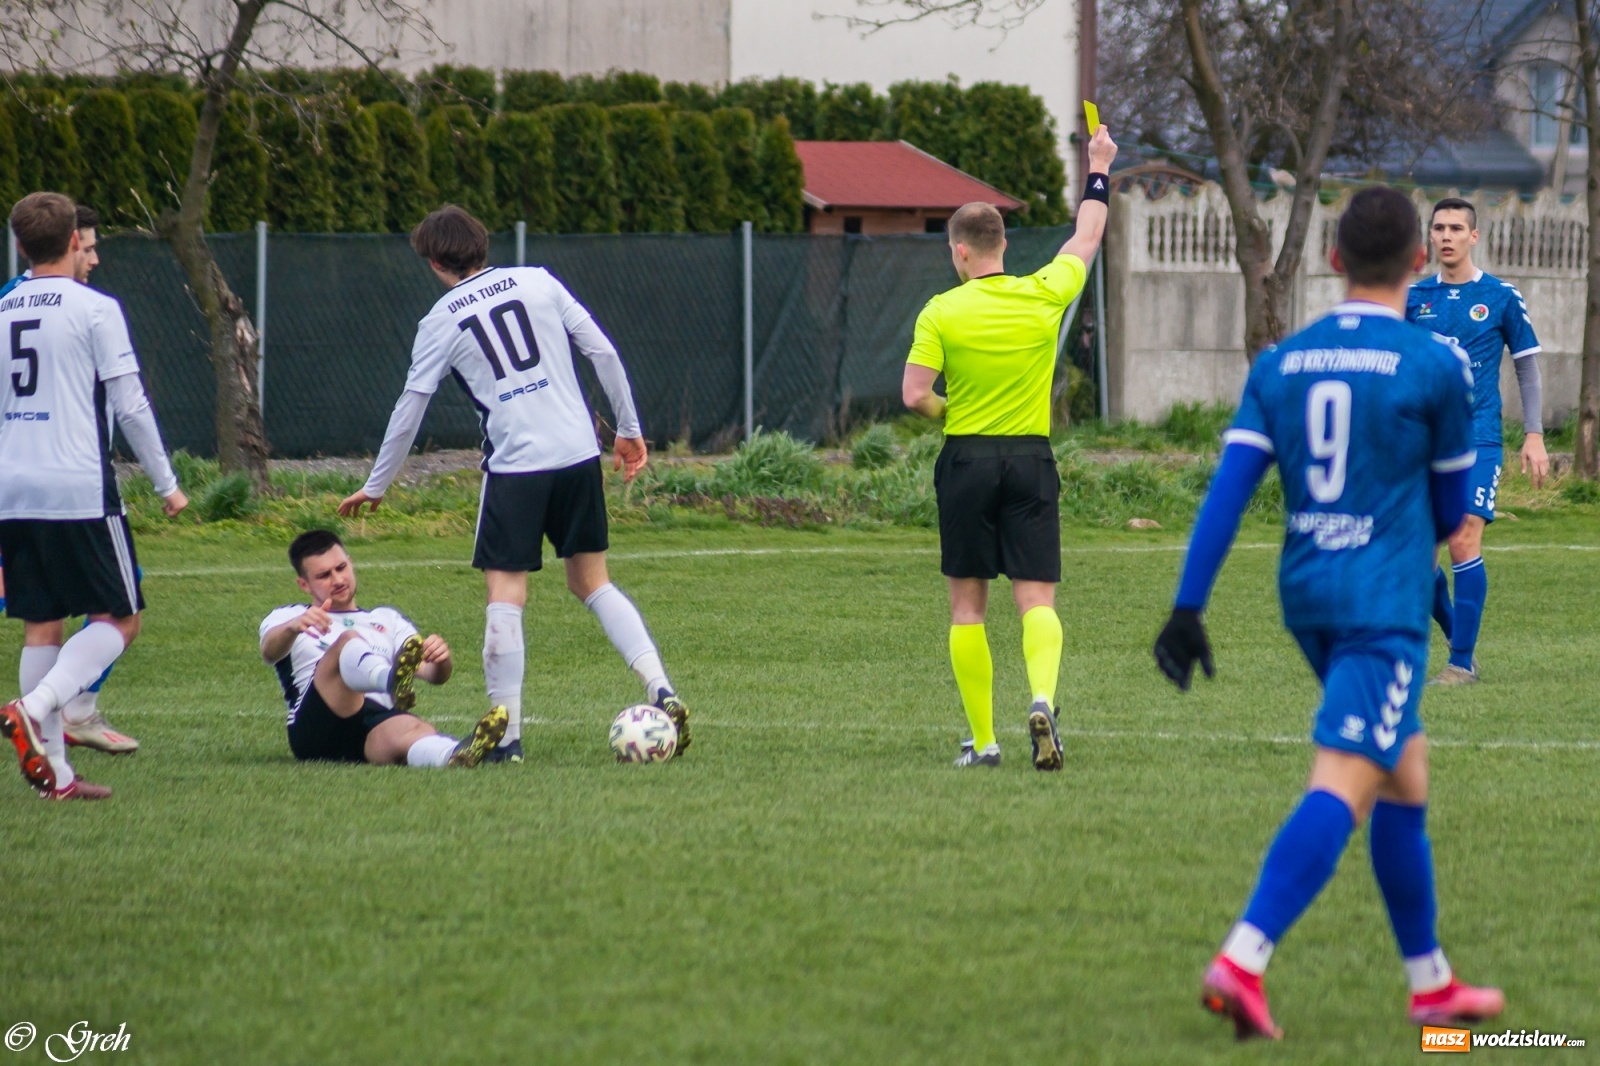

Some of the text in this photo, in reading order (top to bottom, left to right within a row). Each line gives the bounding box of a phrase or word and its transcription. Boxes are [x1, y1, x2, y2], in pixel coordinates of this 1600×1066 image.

[0, 293, 62, 312] UNIA TURZA
[447, 277, 518, 314] UNIA TURZA
[10, 318, 41, 397] 5
[457, 299, 541, 381] 10
[1305, 379, 1352, 504] 9
[1474, 486, 1486, 507] 5
